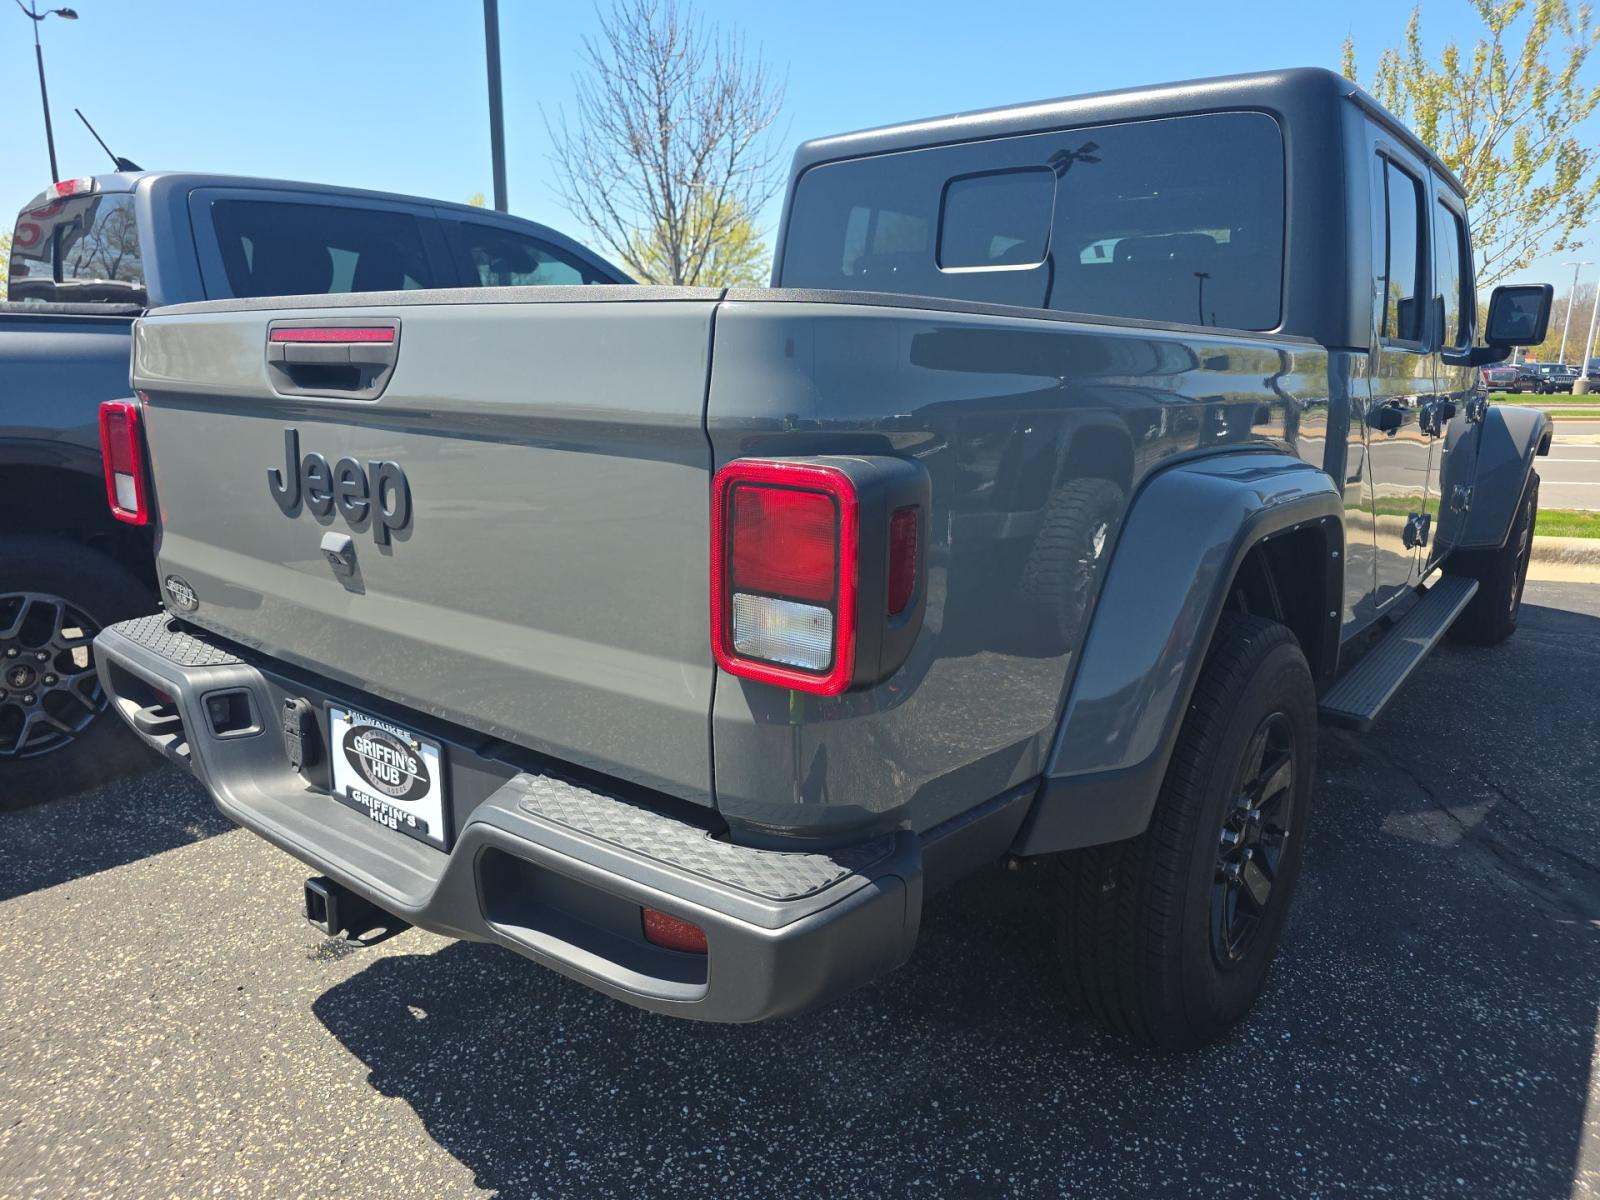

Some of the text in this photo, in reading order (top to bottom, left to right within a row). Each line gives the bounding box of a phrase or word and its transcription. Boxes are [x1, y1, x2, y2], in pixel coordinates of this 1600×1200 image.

[267, 428, 412, 546] Jeep
[348, 710, 411, 739] MILWAUKEE
[354, 736, 417, 774] GRIFFIN'S
[373, 761, 399, 784] HUB
[352, 790, 416, 827] GRIFFIN'S
[370, 808, 398, 829] HUB
